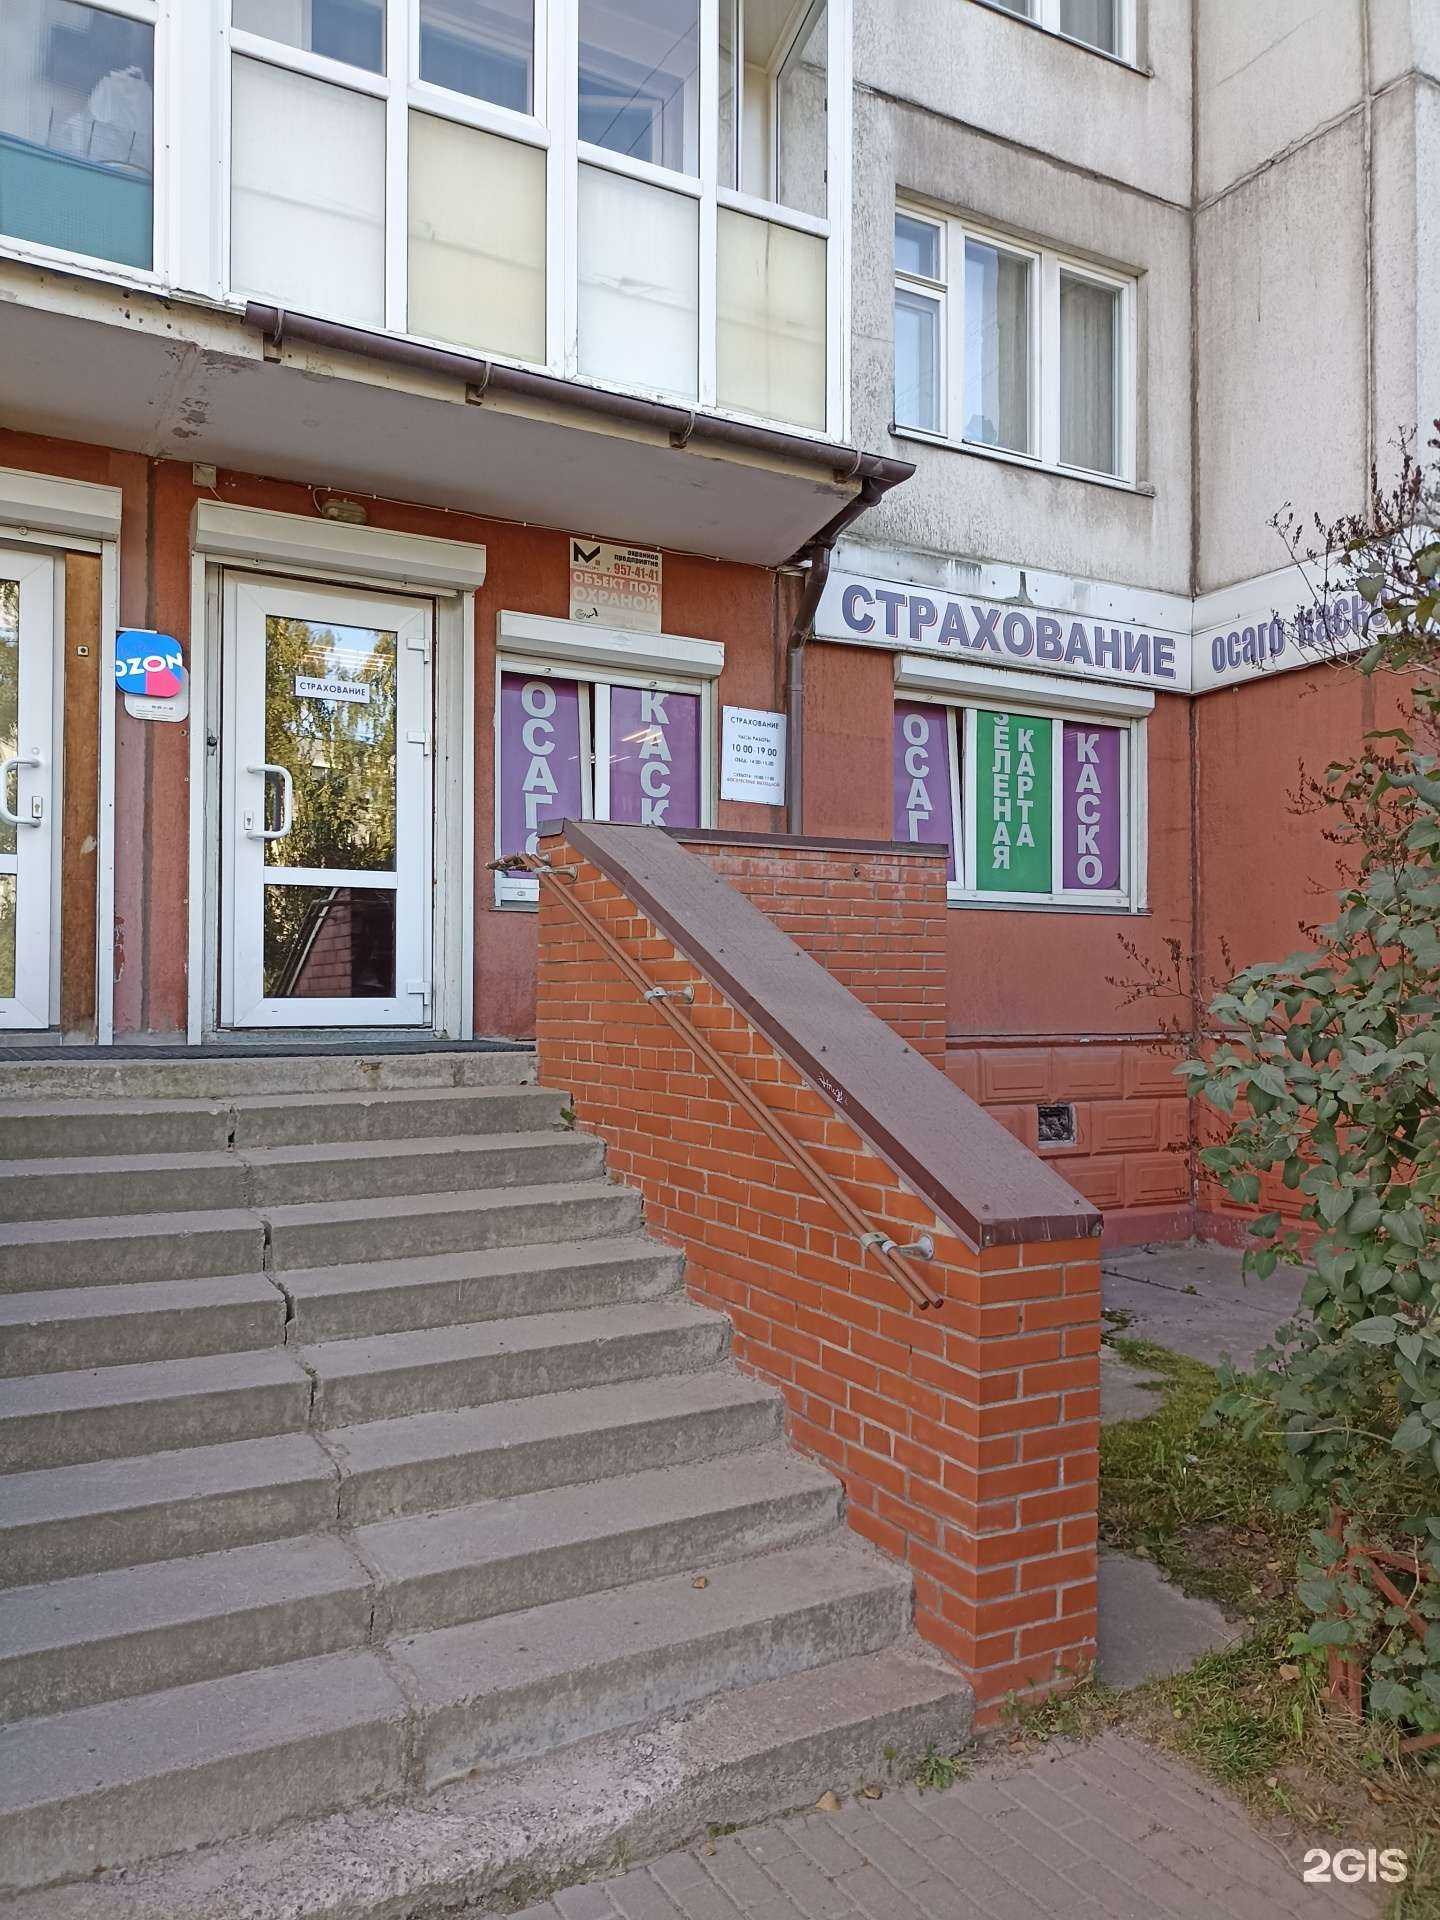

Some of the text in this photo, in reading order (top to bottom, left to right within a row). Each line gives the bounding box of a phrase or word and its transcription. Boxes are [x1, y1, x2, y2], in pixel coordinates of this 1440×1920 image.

[573, 570, 659, 598] ОБЪЕКТ ПОД
[613, 562, 659, 582] 957-41-41
[573, 586, 659, 613] ОХРАНОЙ
[841, 584, 1176, 680] СТРАХОВАНИЕ
[299, 681, 366, 696] СТРАХОВАНИЕ
[730, 716, 779, 730] СТРАХОВАНИЕ
[521, 681, 559, 855] ОСАГ
[1016, 728, 1036, 848] КАРТА
[1075, 732, 1103, 886] КАСКО
